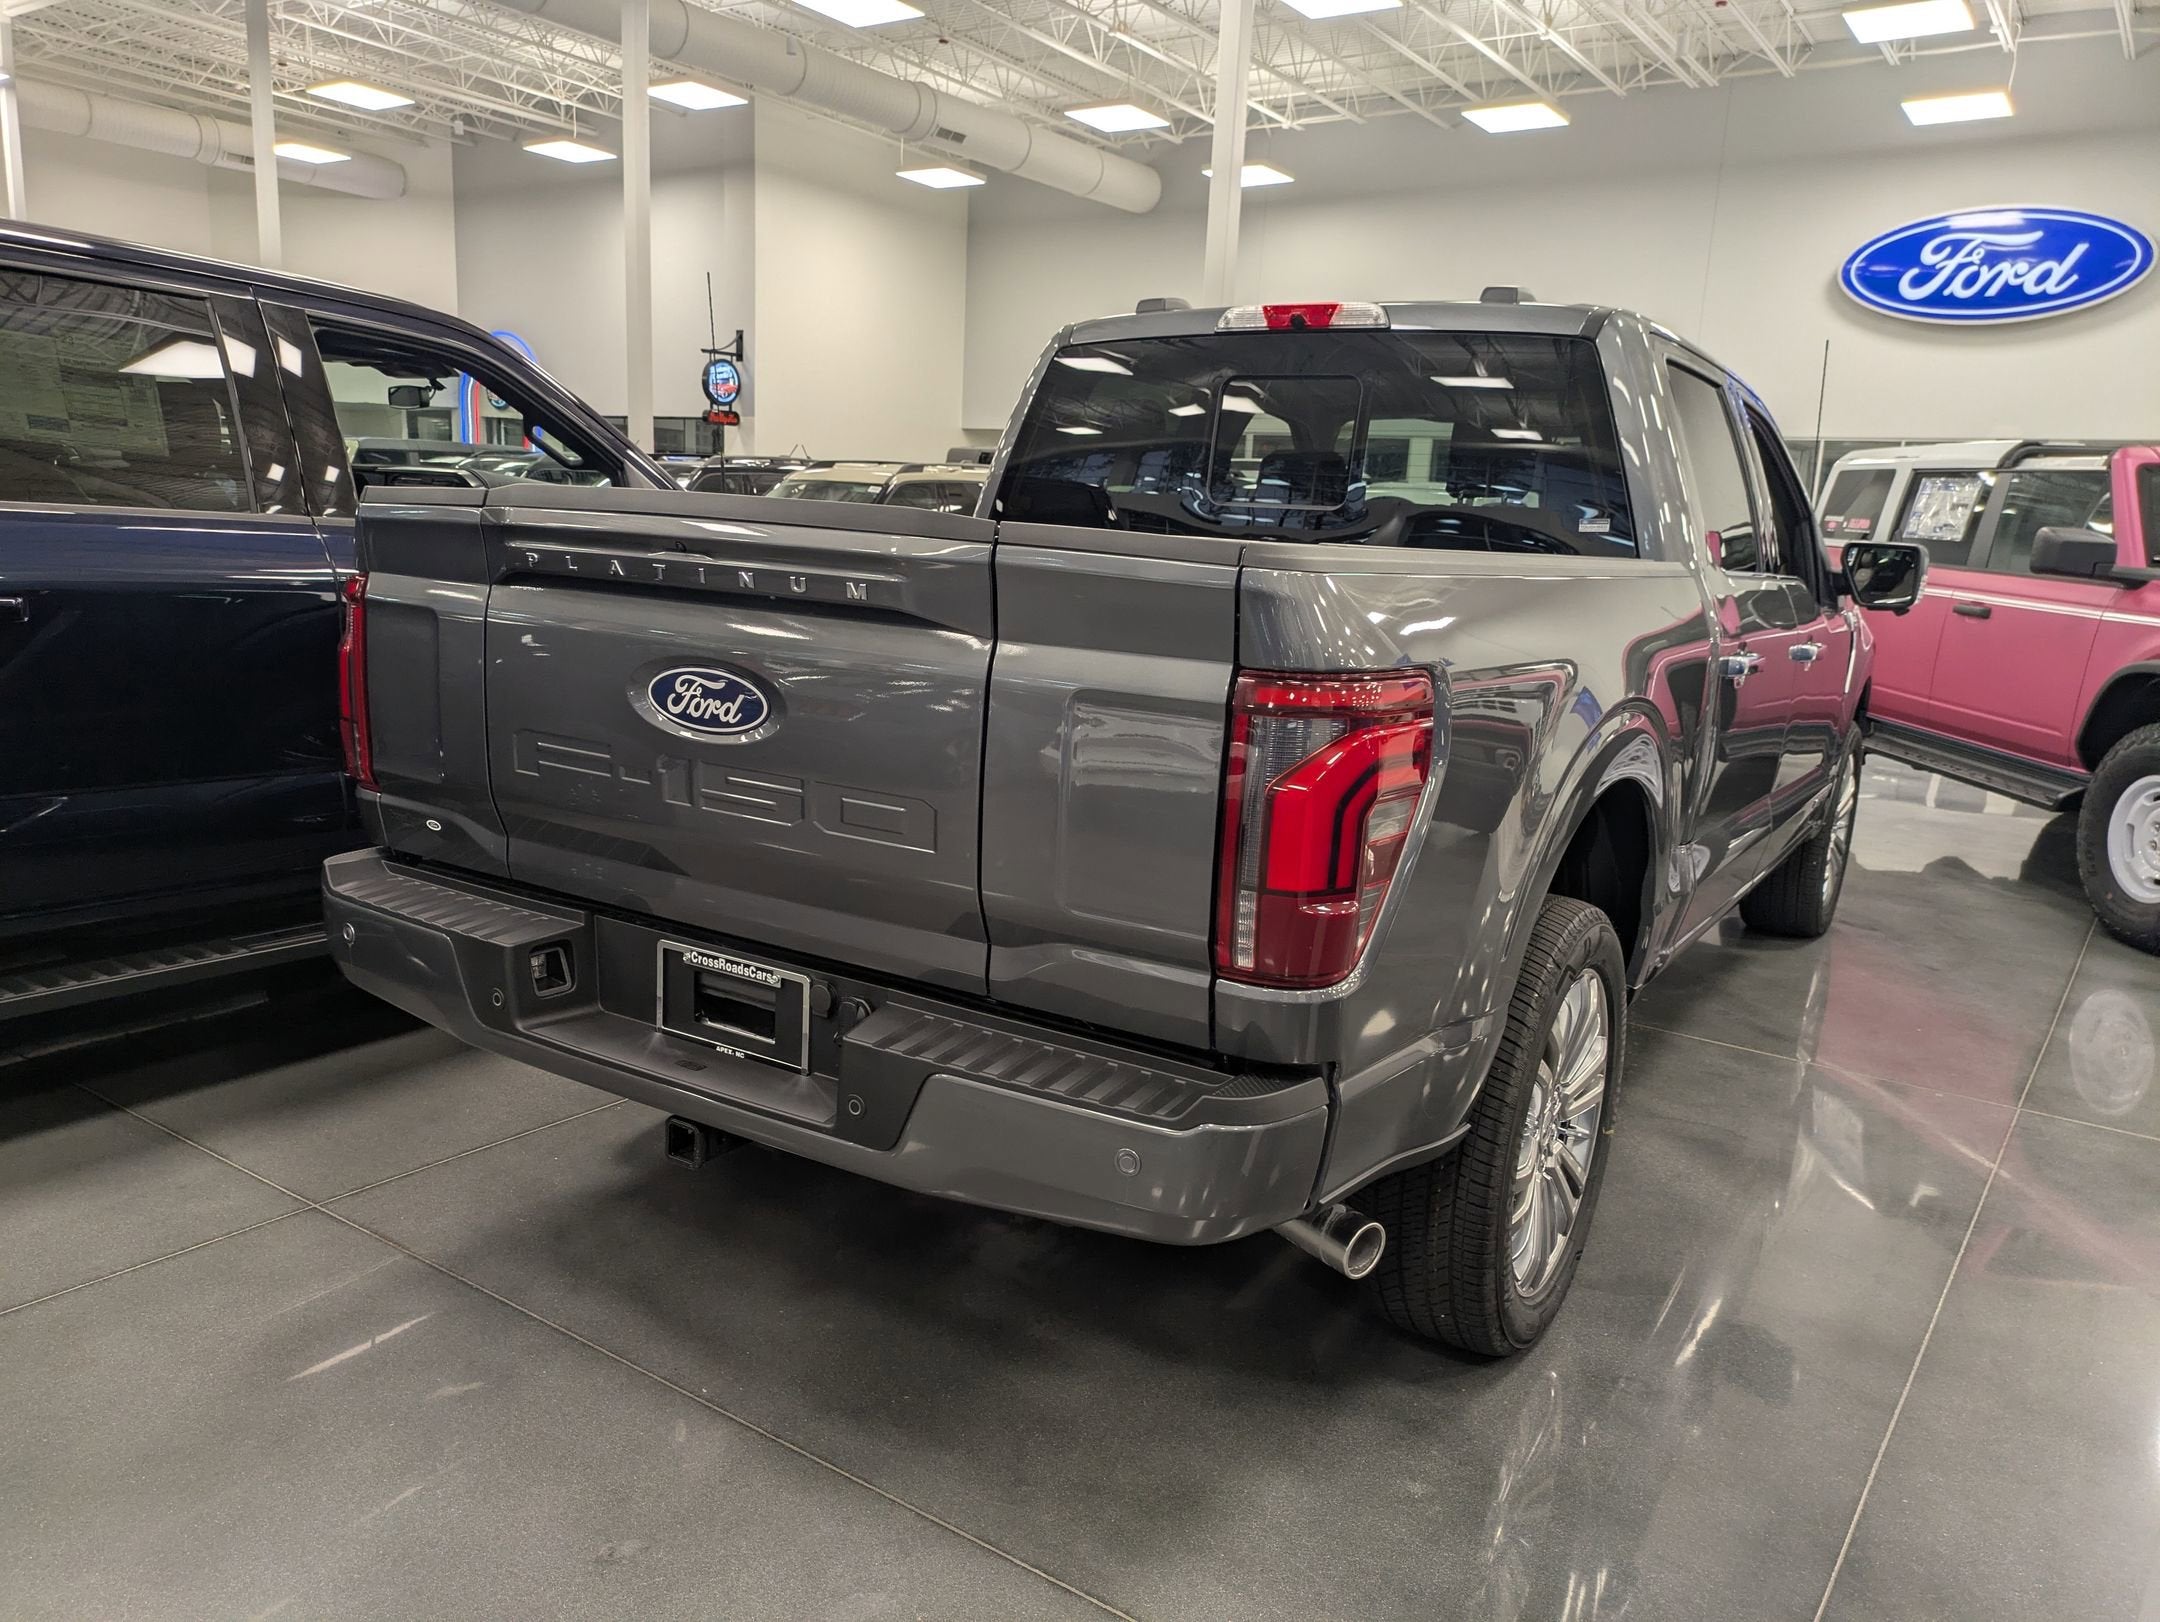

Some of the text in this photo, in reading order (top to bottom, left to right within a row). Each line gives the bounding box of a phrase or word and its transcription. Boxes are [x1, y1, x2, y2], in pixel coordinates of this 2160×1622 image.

[1897, 230, 2091, 301] Ford
[525, 552, 868, 601] PLATINUM
[666, 673, 743, 724] Ford
[514, 729, 938, 854] F-150
[691, 951, 773, 982] CrossRoadsCars
